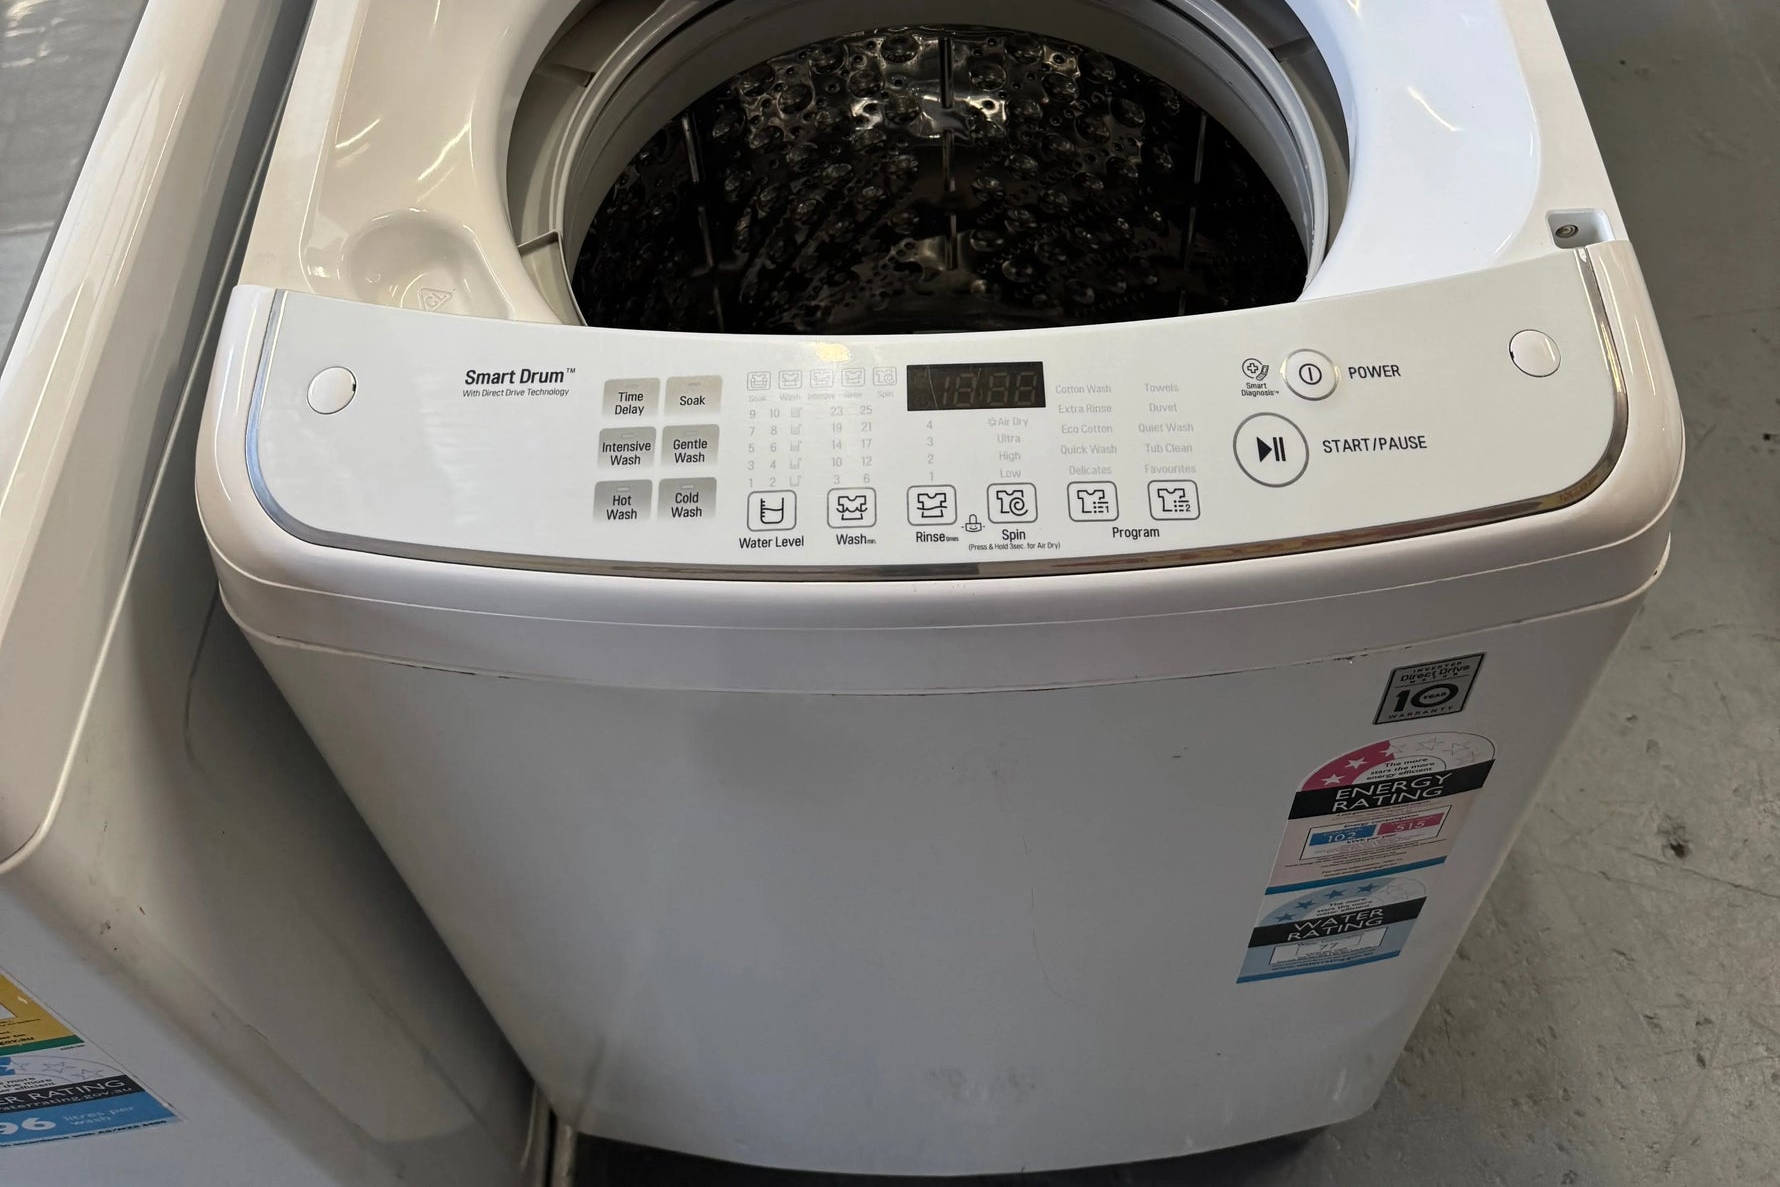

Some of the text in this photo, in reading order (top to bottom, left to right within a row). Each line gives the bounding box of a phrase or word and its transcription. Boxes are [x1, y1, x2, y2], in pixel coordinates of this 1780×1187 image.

[464, 369, 517, 385] Smart
[1348, 364, 1402, 380] POWER
[1055, 384, 1112, 395] Cotton Wash
[1144, 383, 1180, 393] Towels
[1245, 381, 1267, 390] Smart
[462, 388, 570, 398] With Direct Drive Technology
[618, 391, 644, 403] Time
[679, 395, 706, 407] Soak
[614, 404, 645, 417] Delay
[769, 408, 780, 419] 10
[830, 405, 873, 416] 23 25
[1058, 403, 1112, 414] Extra Rinse
[1148, 402, 1178, 413] Duvet
[832, 421, 873, 433] 19 21
[925, 420, 933, 430] 4
[997, 416, 1029, 428] Air Dry
[1138, 422, 1195, 433] Quiet Wash
[770, 425, 778, 436] 8
[1061, 424, 1113, 434] Eco Cotton
[672, 438, 708, 450] Gentle
[832, 438, 872, 450] 14 17
[926, 437, 934, 447] 3
[996, 433, 1021, 443] Ultra
[601, 440, 652, 453] Intensive
[1060, 444, 1118, 455] Quick Wash
[1144, 443, 1193, 454] Tub Clean
[1322, 435, 1428, 454] START/PAUSE
[609, 454, 642, 466] Wash
[673, 452, 706, 464] Wash
[832, 456, 873, 467] 10 12
[927, 454, 935, 464] 2
[999, 451, 1021, 462] High
[1000, 468, 1022, 479] Low
[1068, 465, 1112, 475] Delicates
[1144, 464, 1197, 475] Favourites
[833, 473, 871, 485] 3 6
[612, 494, 632, 506] Hot
[674, 492, 700, 504] Cold
[606, 508, 638, 521] Wash
[671, 506, 703, 518] Wash
[835, 533, 867, 545] Wash
[915, 531, 946, 543] Rinse
[1001, 528, 1026, 543] Spin
[1112, 526, 1160, 540] Program
[738, 535, 805, 549] Water Level
[968, 543, 988, 551] (Press
[994, 542, 1009, 550] Hold
[1026, 542, 1036, 550] for
[1037, 542, 1047, 550] Air
[1047, 541, 1061, 550] Dry)
[1400, 669, 1438, 683] Direct
[1438, 664, 1471, 675] Drive
[1393, 683, 1459, 713] 10
[1422, 691, 1448, 700] YEAR
[1388, 705, 1454, 719] WARRANTY
[1366, 767, 1433, 781] energy efficient
[1335, 772, 1453, 800] ENERGY
[1332, 785, 1445, 812] RATING
[1294, 908, 1384, 931] WATER
[1287, 916, 1384, 942] RATING
[28, 1079, 125, 1101] RATING
